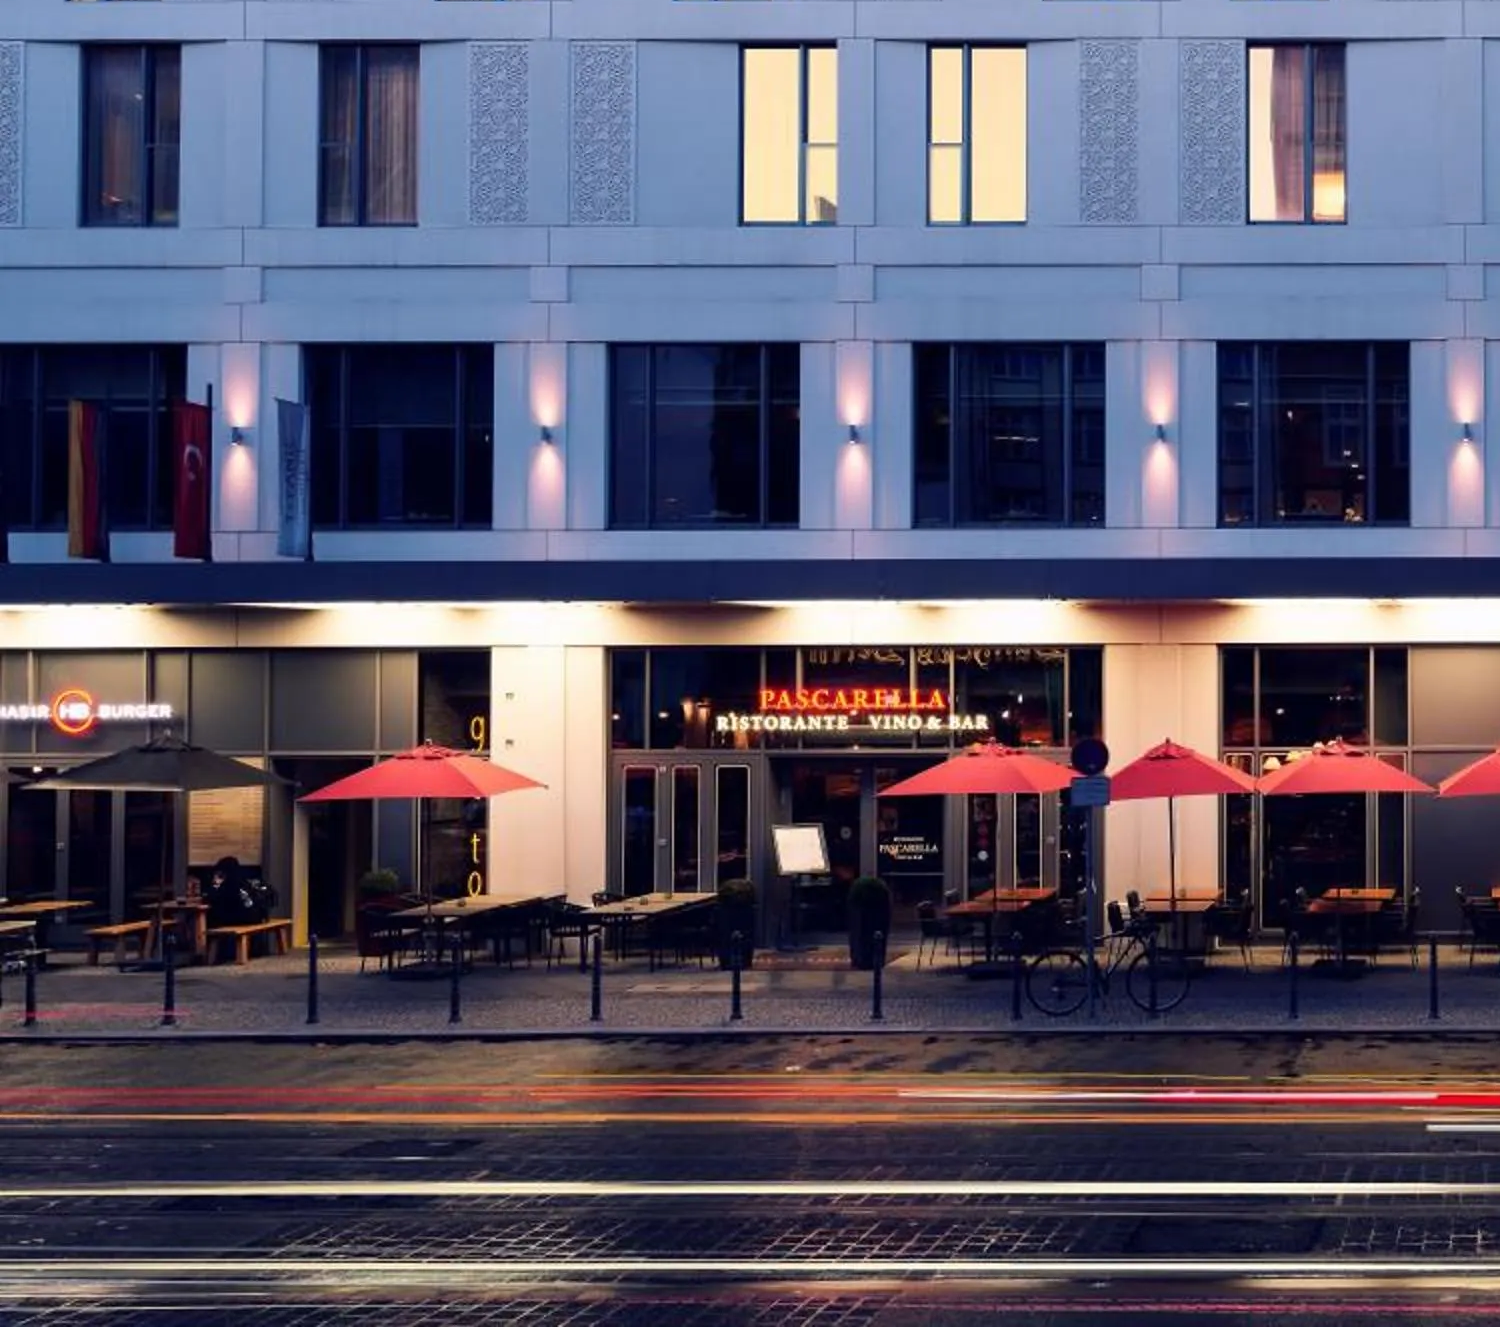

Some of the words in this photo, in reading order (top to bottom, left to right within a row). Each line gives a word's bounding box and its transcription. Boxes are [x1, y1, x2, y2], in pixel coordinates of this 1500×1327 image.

[760, 688, 946, 710] PASCARELLA
[98, 704, 171, 719] BURGER
[716, 714, 849, 731] RISTORANTE
[868, 714, 923, 731] VINO
[926, 715, 942, 731] &
[949, 714, 989, 731] BAR
